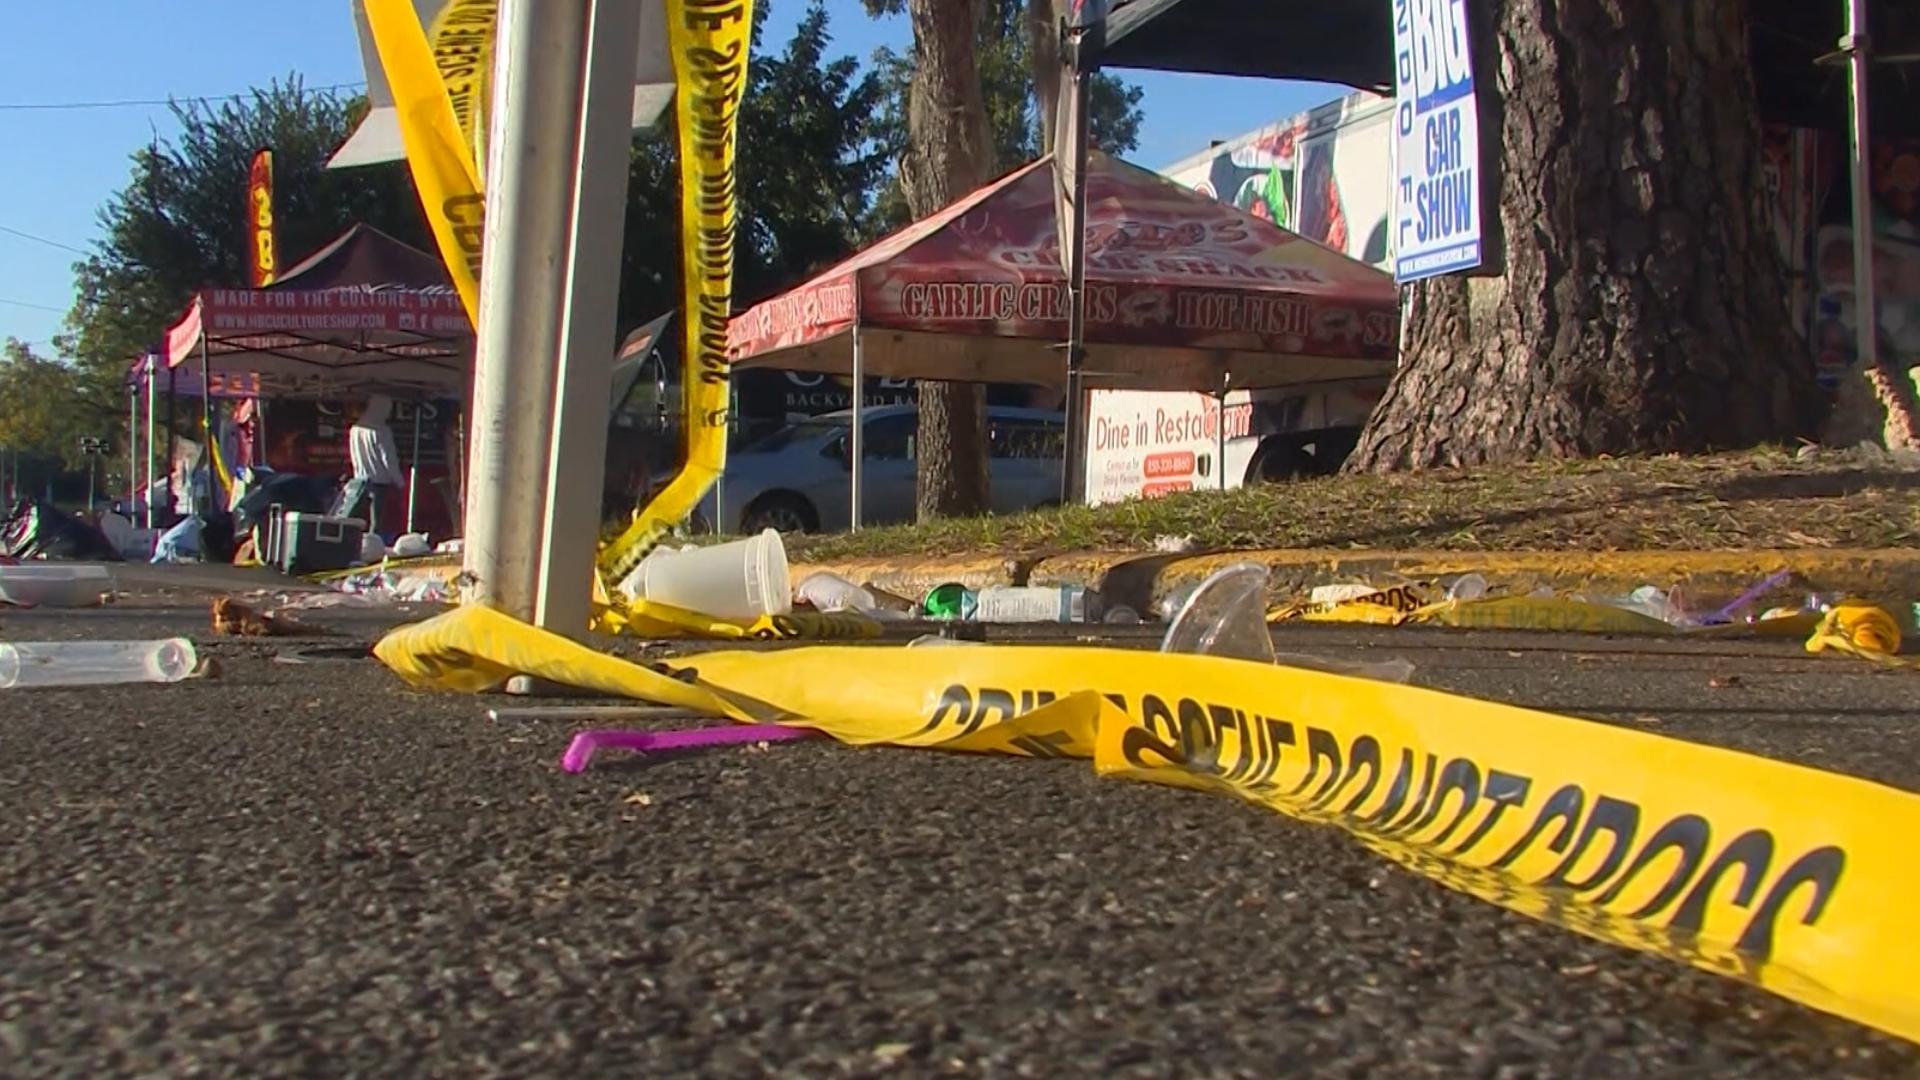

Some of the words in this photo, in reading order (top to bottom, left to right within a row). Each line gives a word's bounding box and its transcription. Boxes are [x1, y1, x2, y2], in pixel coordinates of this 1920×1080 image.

[1413, 0, 1472, 98] BIG
[1425, 105, 1462, 177] CAR
[1416, 168, 1472, 243] SHOW
[213, 288, 259, 306] MADE
[264, 290, 296, 307] FOR
[302, 290, 330, 307] THE
[420, 292, 439, 309] BY
[902, 282, 1015, 321] GARLIC
[1176, 290, 1240, 333] HOT
[1241, 296, 1311, 337] FISH
[1095, 415, 1131, 451] Dine
[1135, 411, 1149, 448] in
